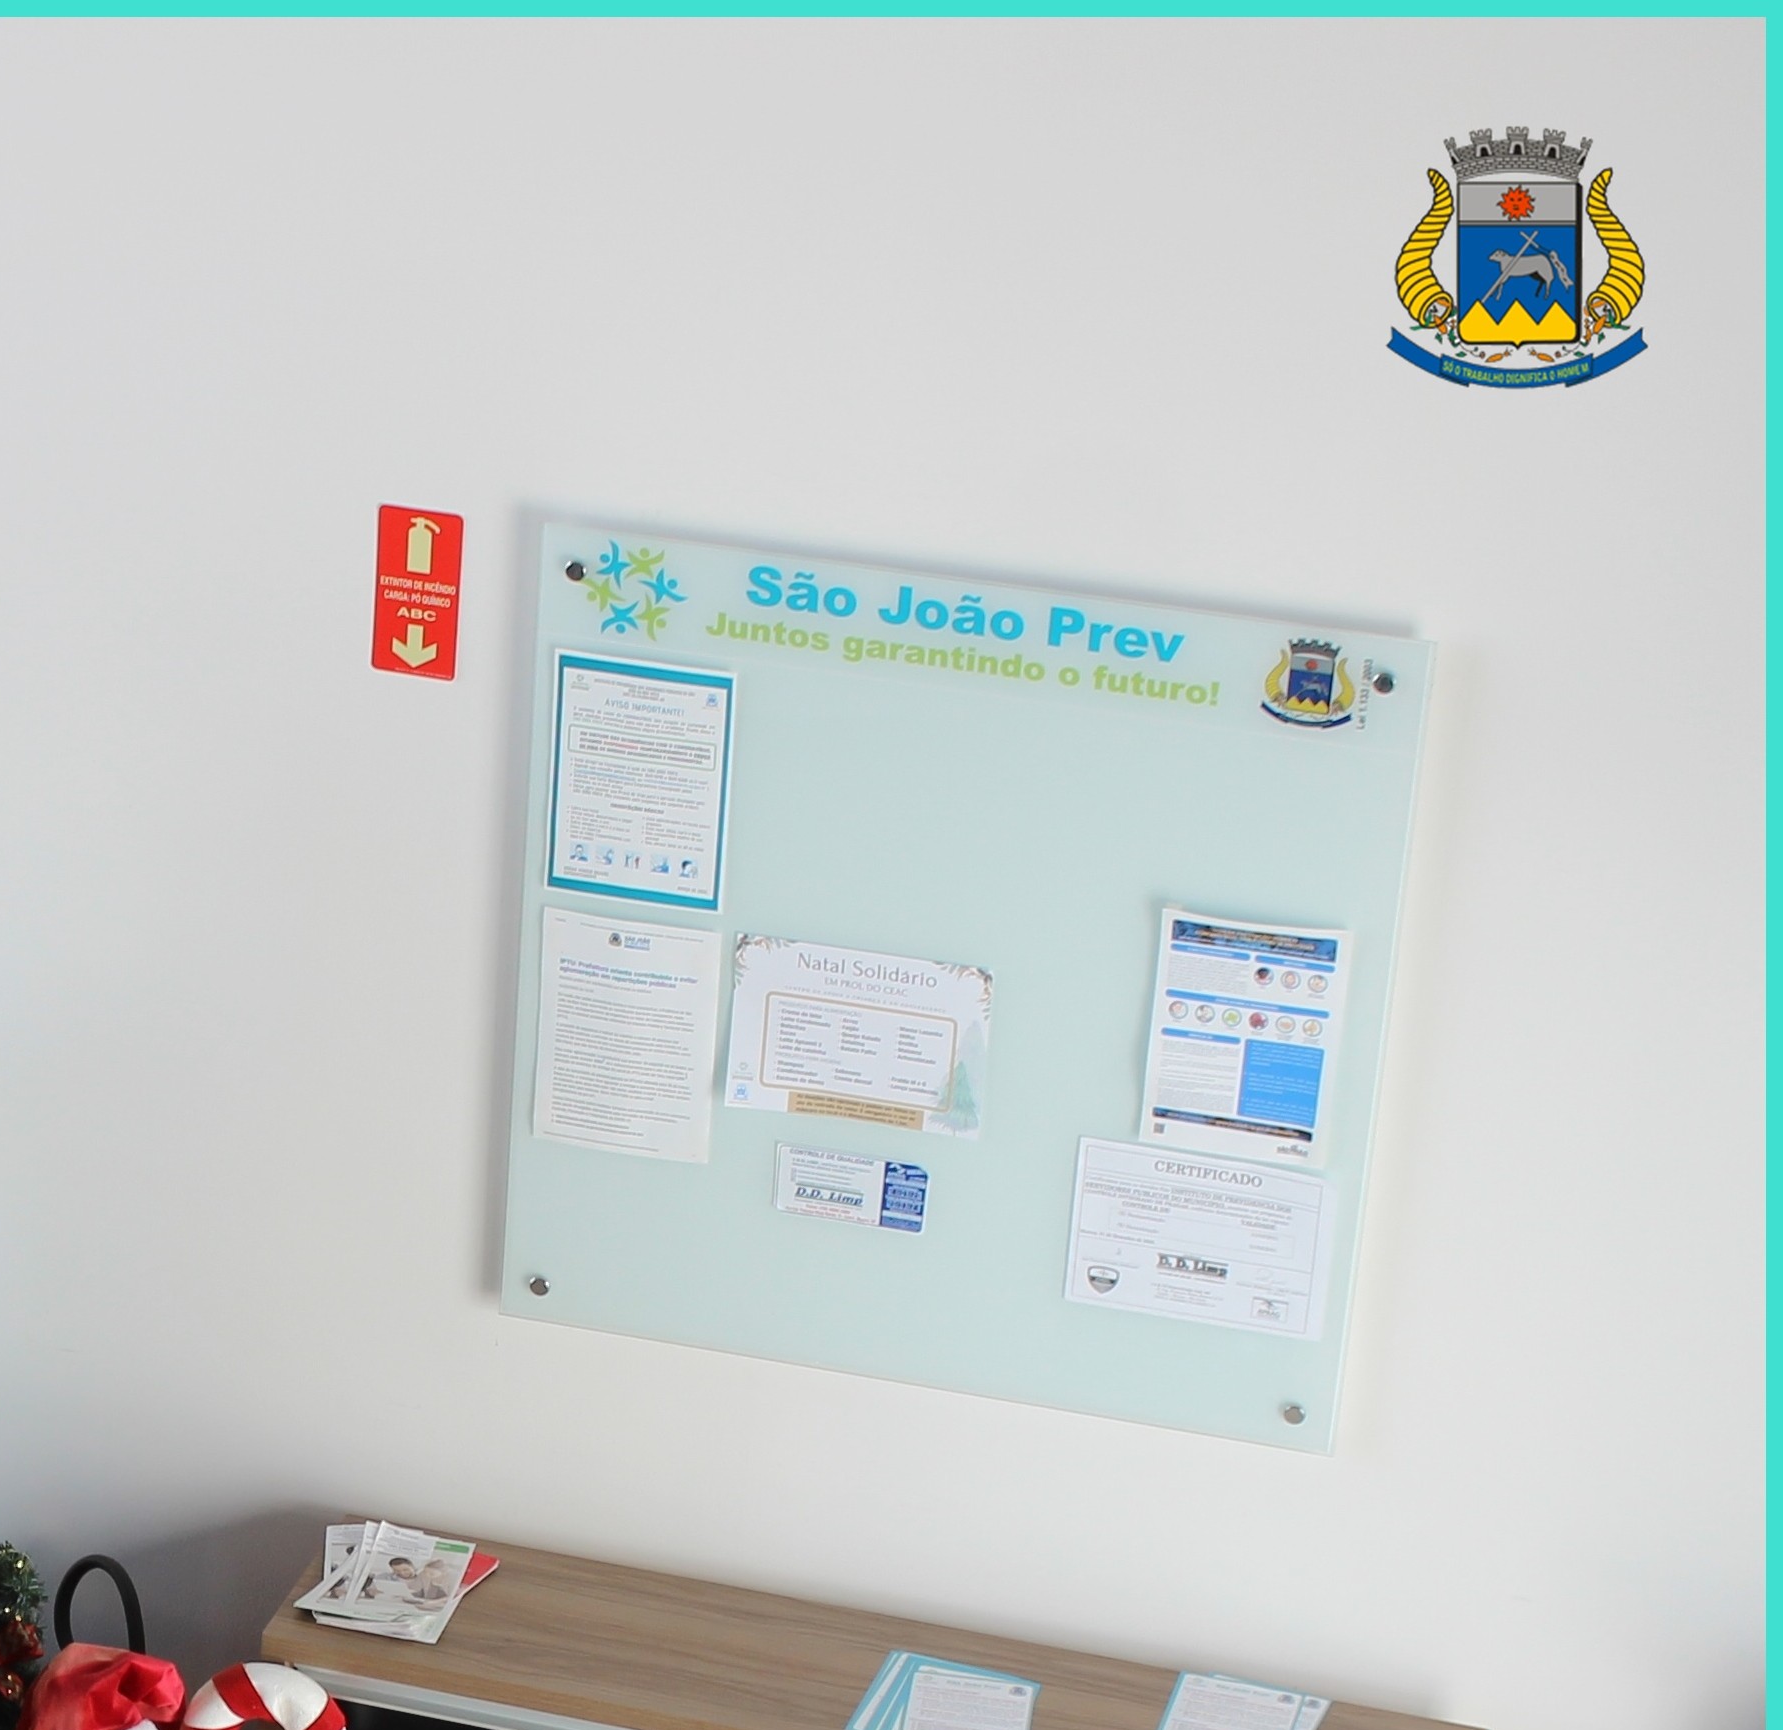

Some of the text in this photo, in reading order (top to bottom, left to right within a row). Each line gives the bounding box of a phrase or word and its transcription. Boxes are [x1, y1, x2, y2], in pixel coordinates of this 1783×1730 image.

[380, 575, 456, 595] EXTINTOR DE INCÊNDIO
[411, 592, 421, 604] PÓ
[422, 594, 451, 608] QUÍMICO
[396, 606, 437, 622] ABC
[745, 564, 1186, 663] São João Prev
[705, 611, 1221, 707] Juntos garantindo o futuro!
[604, 698, 629, 710] AVISO
[797, 952, 938, 989] Natal Solidário
[825, 978, 908, 997] EM PROL DO CEAC
[1154, 1160, 1263, 1188] CERTIFICADO
[828, 1191, 864, 1205] Limp
[1193, 1260, 1228, 1278] Limp
